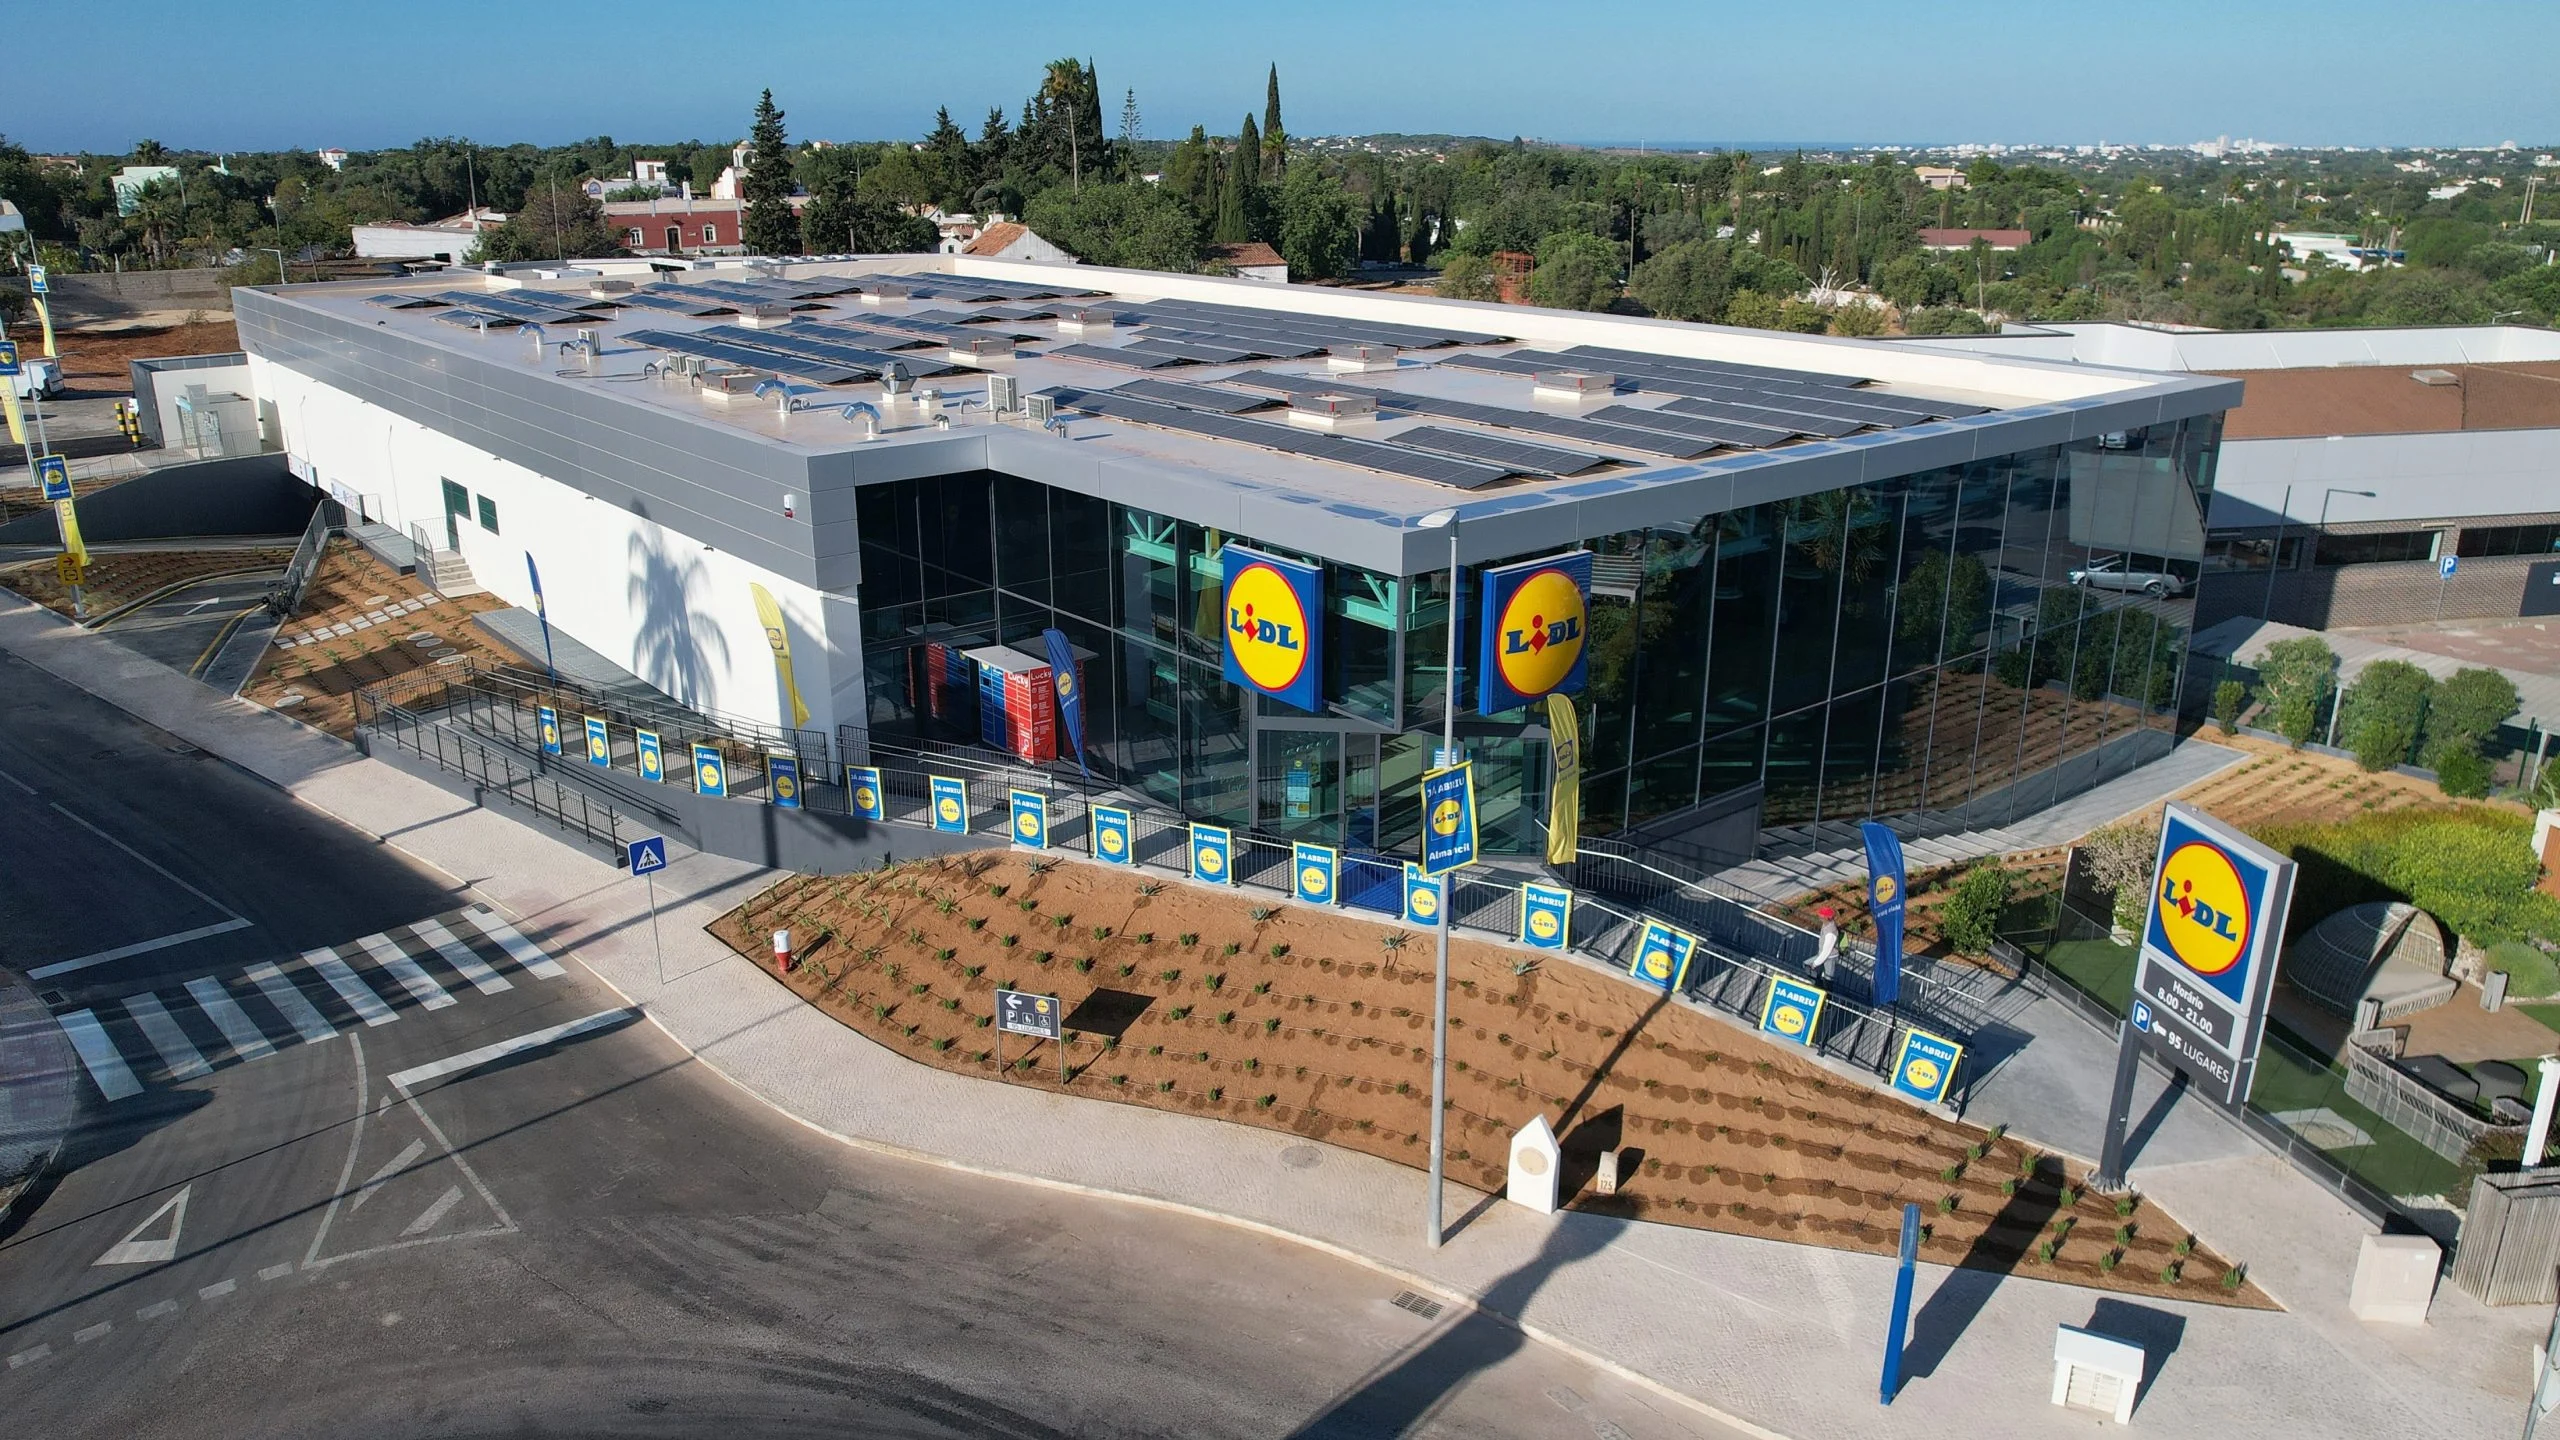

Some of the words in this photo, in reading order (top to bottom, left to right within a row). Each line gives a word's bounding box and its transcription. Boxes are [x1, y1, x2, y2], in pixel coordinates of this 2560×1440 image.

[2444, 557, 2454, 573] P
[1031, 670, 1052, 680] Lucky
[1437, 777, 1465, 795] ABRIU
[1021, 801, 1041, 809] ABRIU
[1105, 816, 1126, 825] ABRIU
[1203, 835, 1225, 844] ABRIU
[1306, 854, 1331, 863] ABRIU
[1428, 843, 1471, 861] Almancil
[1527, 893, 1538, 902] JÁ
[1538, 896, 1564, 907] ABRIU
[1658, 937, 1686, 954] ABRIU
[1775, 986, 1787, 996] JÁ
[1787, 992, 1816, 1006] ABRIU
[2172, 979, 2204, 1010] Horário
[1008, 1011, 1015, 1021] P
[2136, 1007, 2147, 1026] P
[2157, 986, 2179, 1012] 8.00
[2185, 1008, 2213, 1035] 21.00
[1909, 1039, 1922, 1051] JÁ
[1921, 1044, 1953, 1061] ABRIU
[2168, 1031, 2182, 1050] 95
[2182, 1035, 2230, 1084] LUGARES
